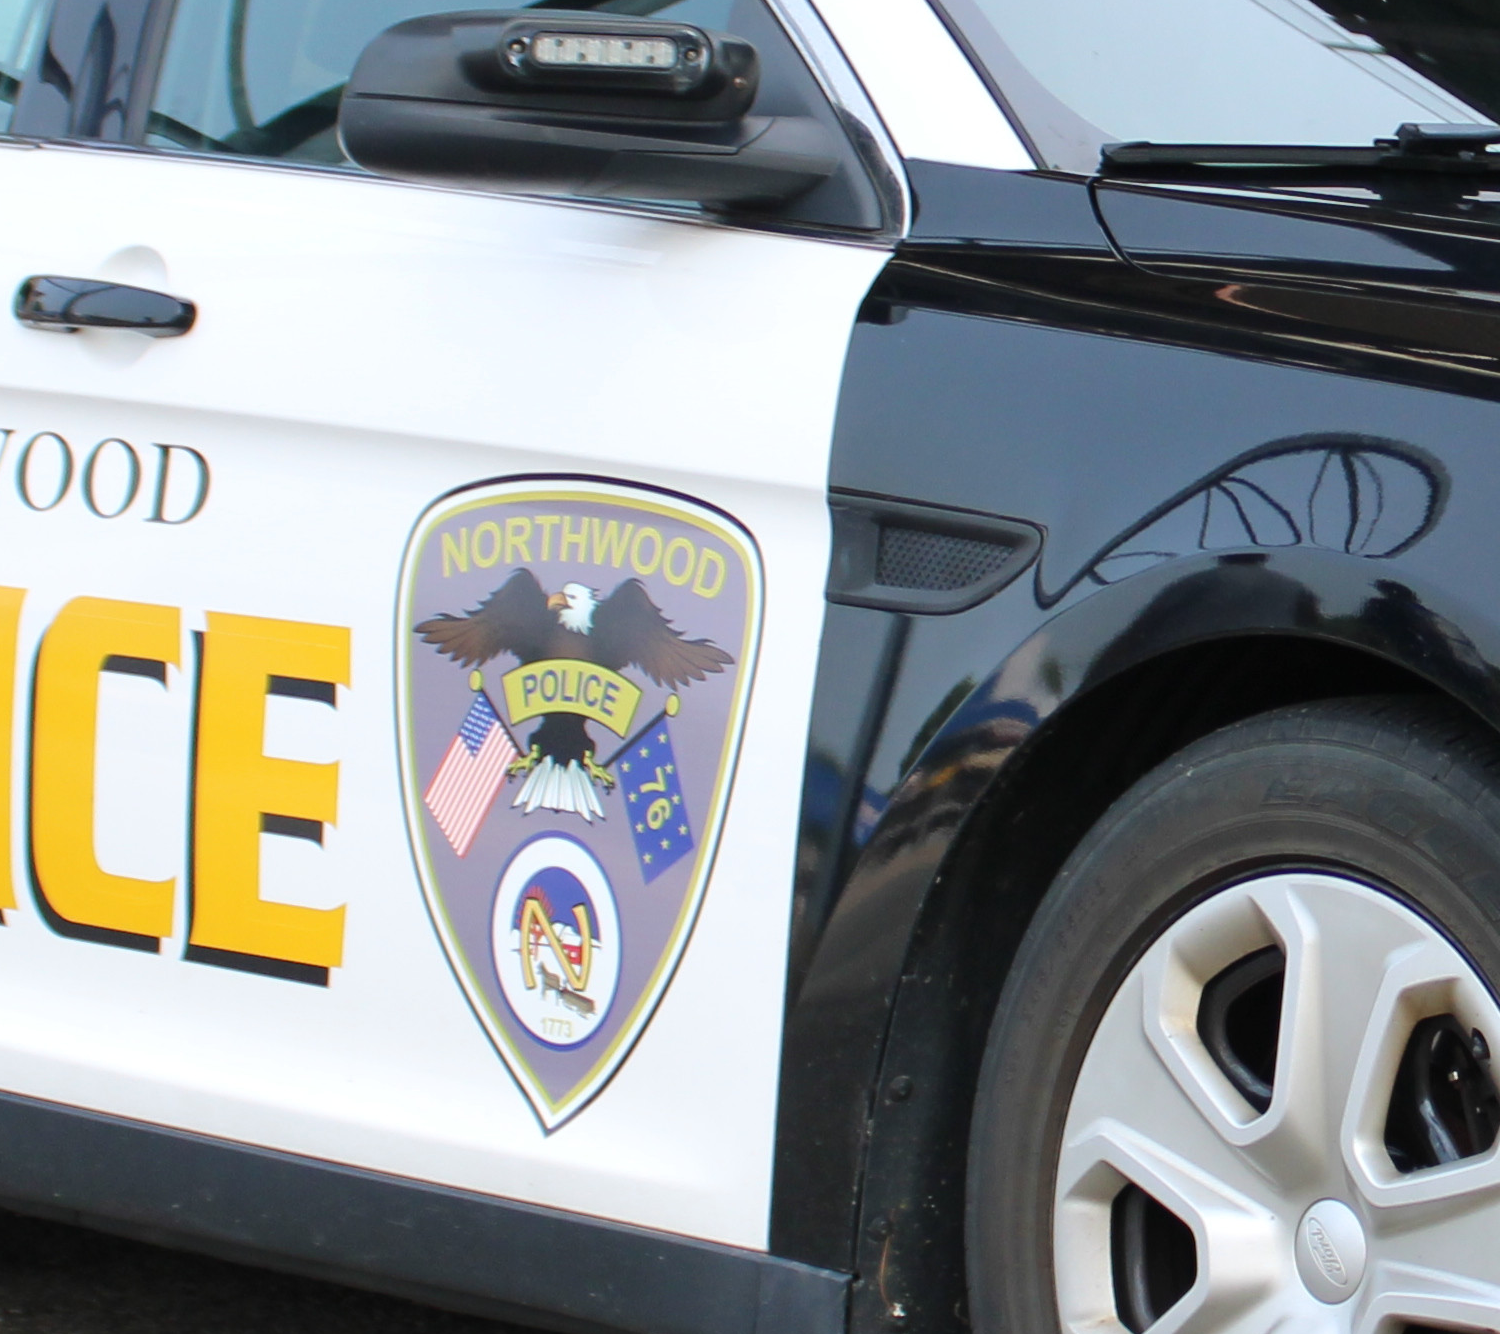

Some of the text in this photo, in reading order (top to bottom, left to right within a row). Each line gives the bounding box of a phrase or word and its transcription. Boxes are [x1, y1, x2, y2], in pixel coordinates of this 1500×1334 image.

[440, 515, 729, 599] NORTHWOOD
[522, 669, 621, 718] POLICE
[640, 766, 673, 830] 76
[540, 1017, 576, 1039] 1773
